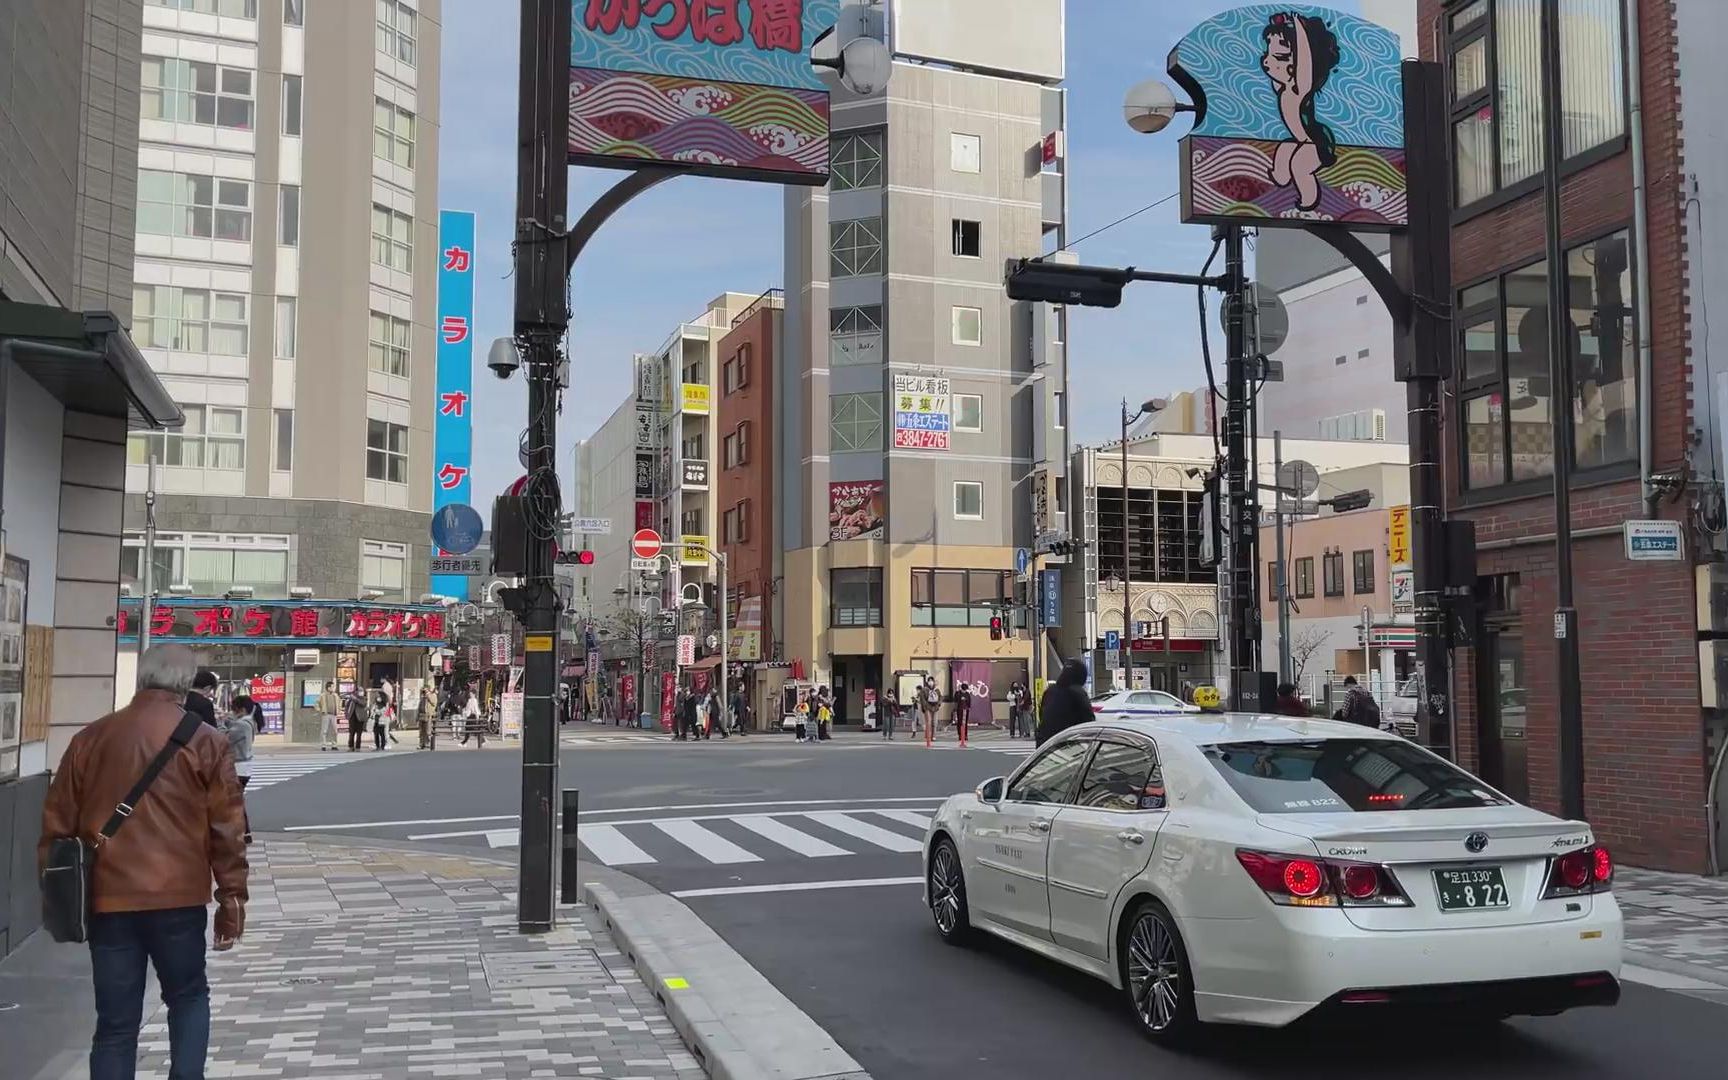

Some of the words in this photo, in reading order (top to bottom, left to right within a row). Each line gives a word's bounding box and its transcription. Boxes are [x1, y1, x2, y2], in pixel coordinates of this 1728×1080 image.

[896, 377, 948, 395] 当ビル看板
[1393, 508, 1407, 562] デニーズ
[432, 560, 480, 571] 歩行者優先
[346, 611, 446, 638] カラオケ館
[1109, 632, 1117, 648] P
[252, 686, 285, 695] EXCHANGE
[1328, 847, 1367, 856] CROWN
[1472, 871, 1490, 882] 330
